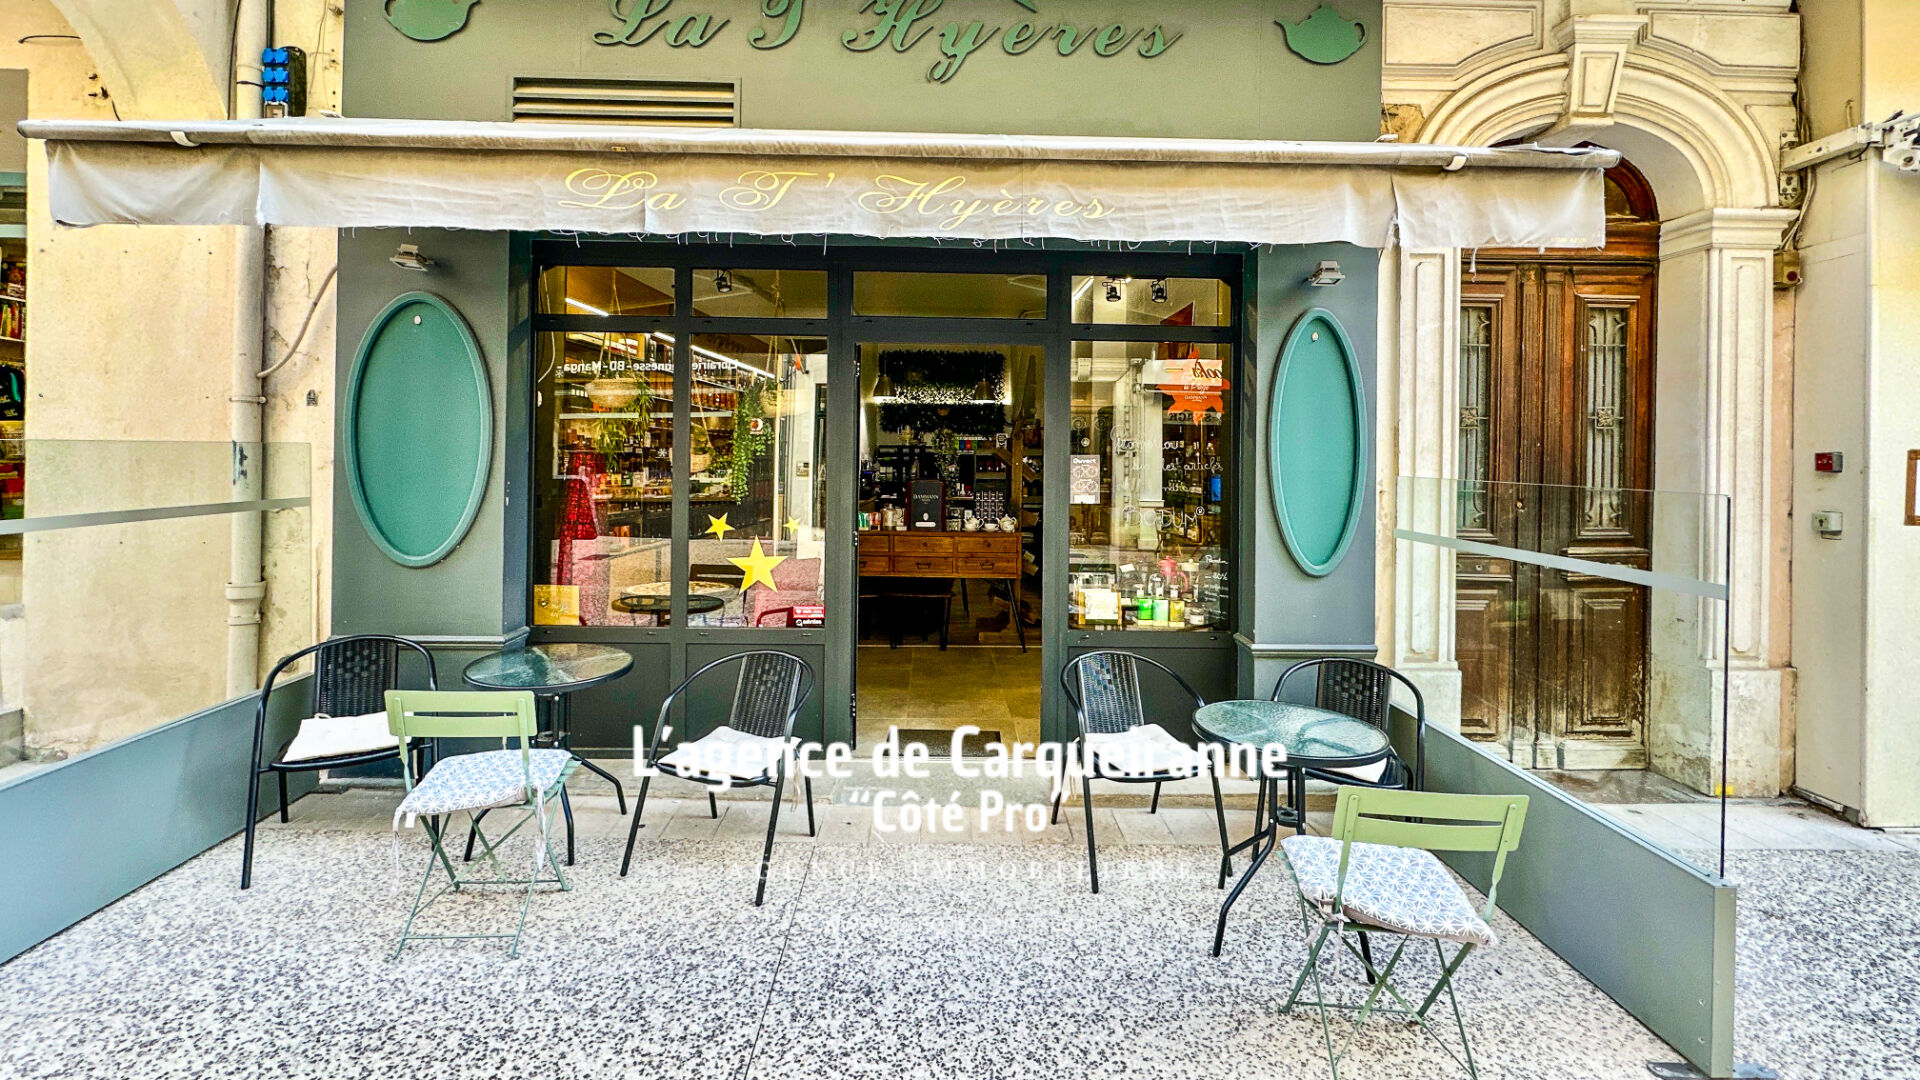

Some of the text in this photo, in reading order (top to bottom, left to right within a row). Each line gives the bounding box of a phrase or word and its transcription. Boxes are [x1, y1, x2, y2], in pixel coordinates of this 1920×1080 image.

[592, 0, 731, 47] La
[841, 0, 1183, 84] Hyères
[558, 168, 687, 210] La
[858, 174, 1115, 231] Hyères
